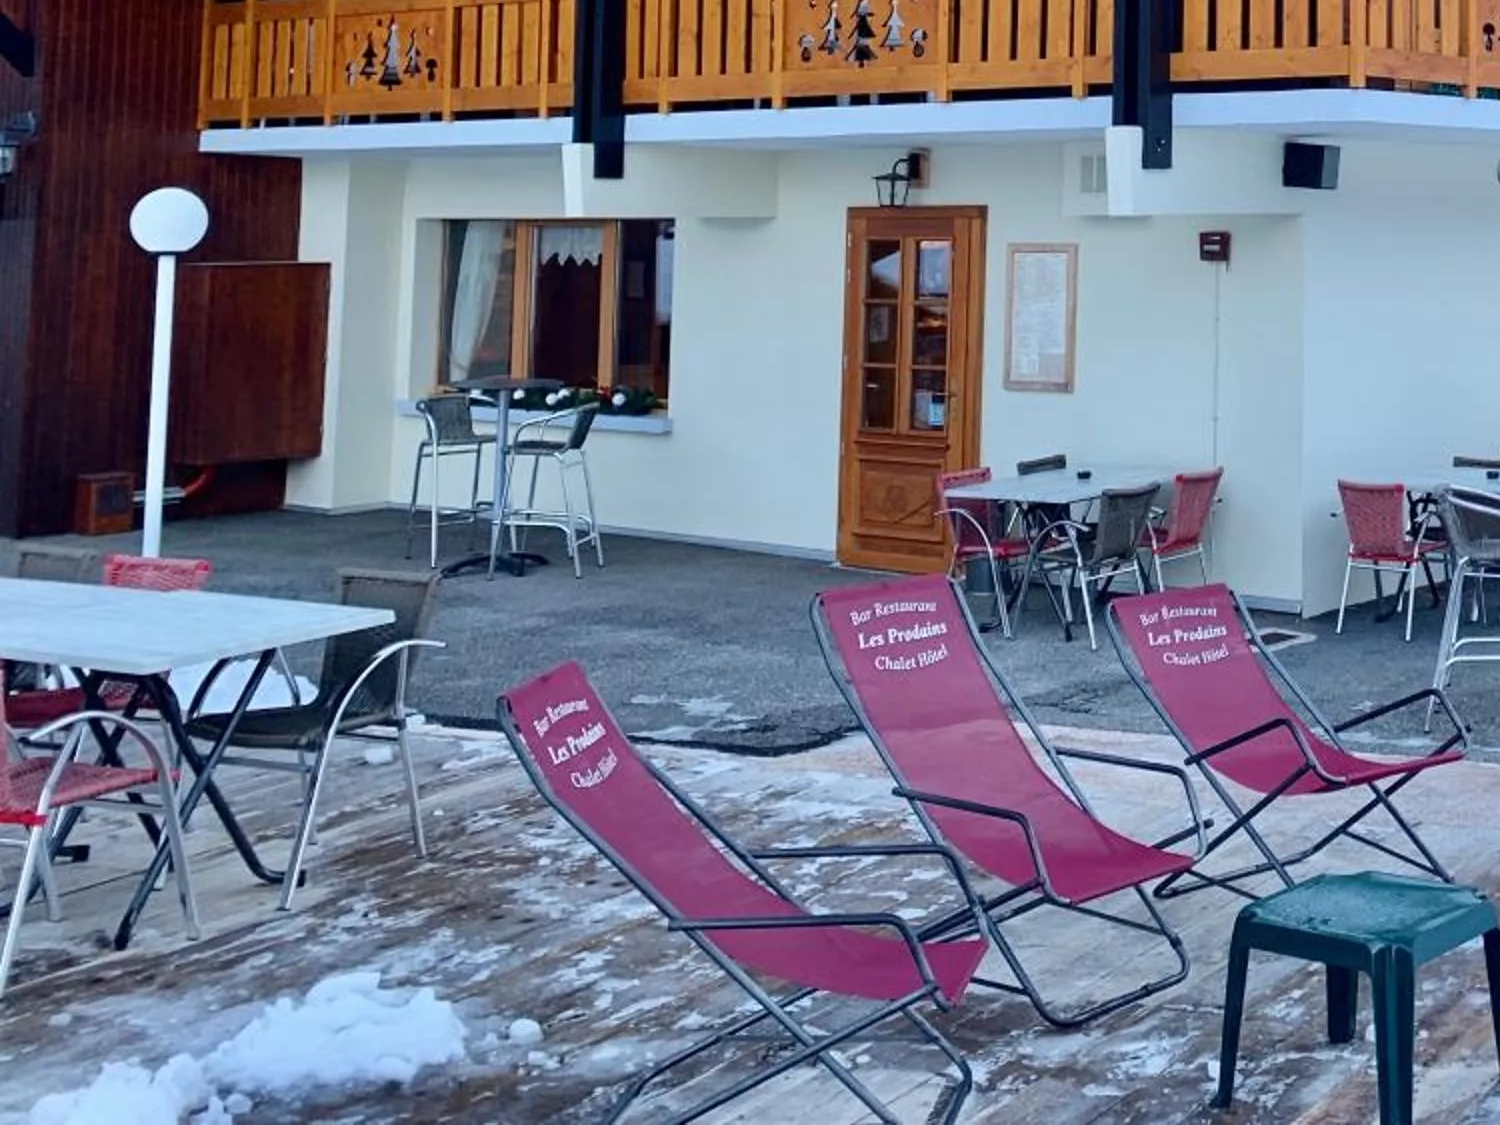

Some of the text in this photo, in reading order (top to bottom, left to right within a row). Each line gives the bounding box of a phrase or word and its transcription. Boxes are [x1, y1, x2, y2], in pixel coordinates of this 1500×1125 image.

[850, 601, 937, 626] Bar Restaurant
[1139, 605, 1217, 626] Bar Restaurant
[858, 621, 947, 650] Les Prodains
[1148, 625, 1227, 647] Les Prodains
[875, 643, 948, 671] Chalet Hôtel
[548, 722, 606, 765] Les Prodains
